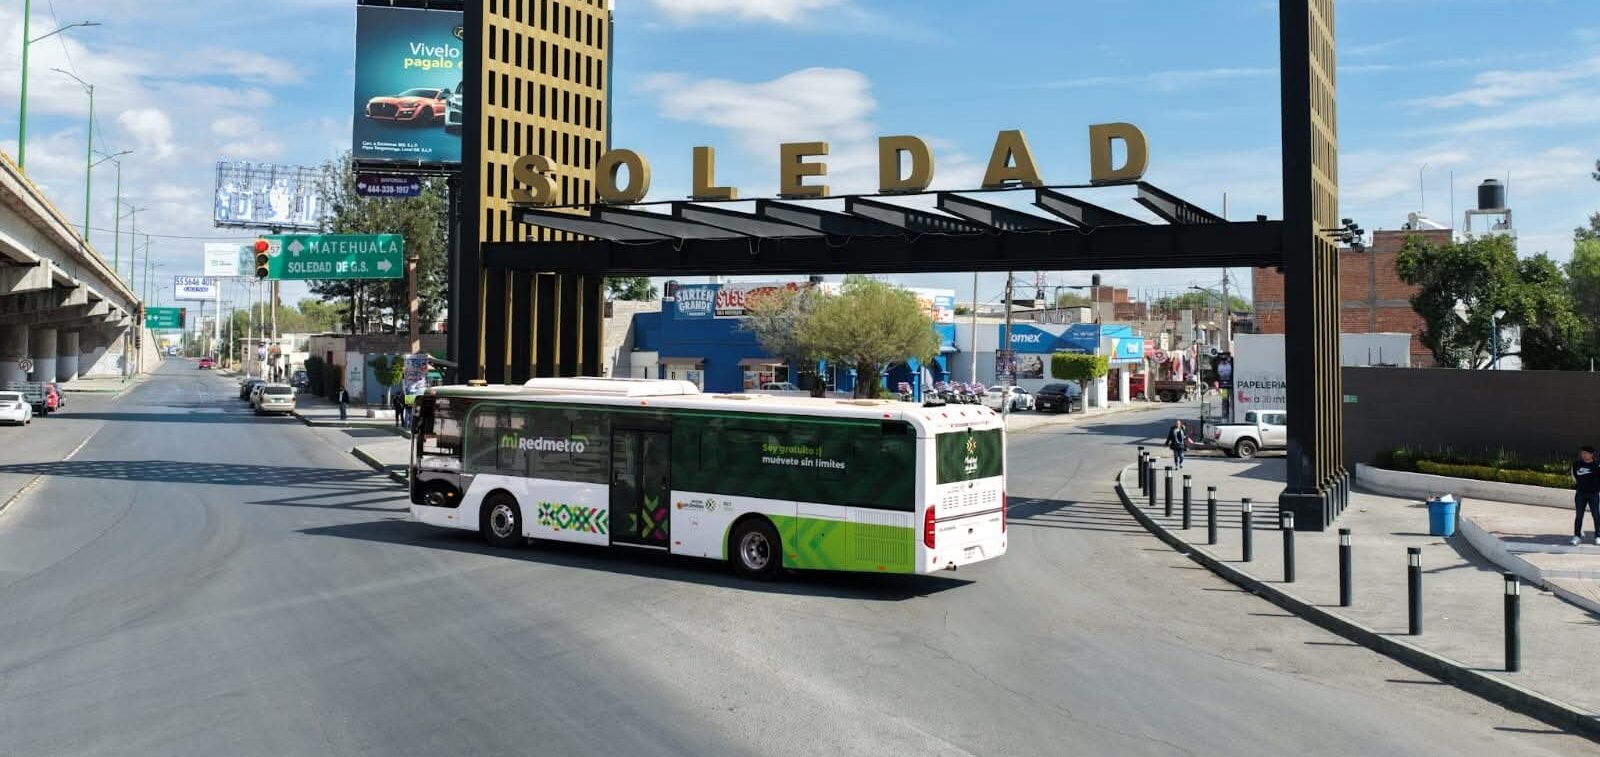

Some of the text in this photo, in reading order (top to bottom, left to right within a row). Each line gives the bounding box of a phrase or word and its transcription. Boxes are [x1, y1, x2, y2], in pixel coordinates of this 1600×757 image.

[511, 122, 1149, 204] SOLEDAD
[309, 240, 399, 254] MATEHUALA
[287, 261, 369, 273] SOLEDAD DE G.S.
[679, 300, 713, 313] GRANDE
[1008, 332, 1042, 343] omex
[800, 457, 814, 467] sin
